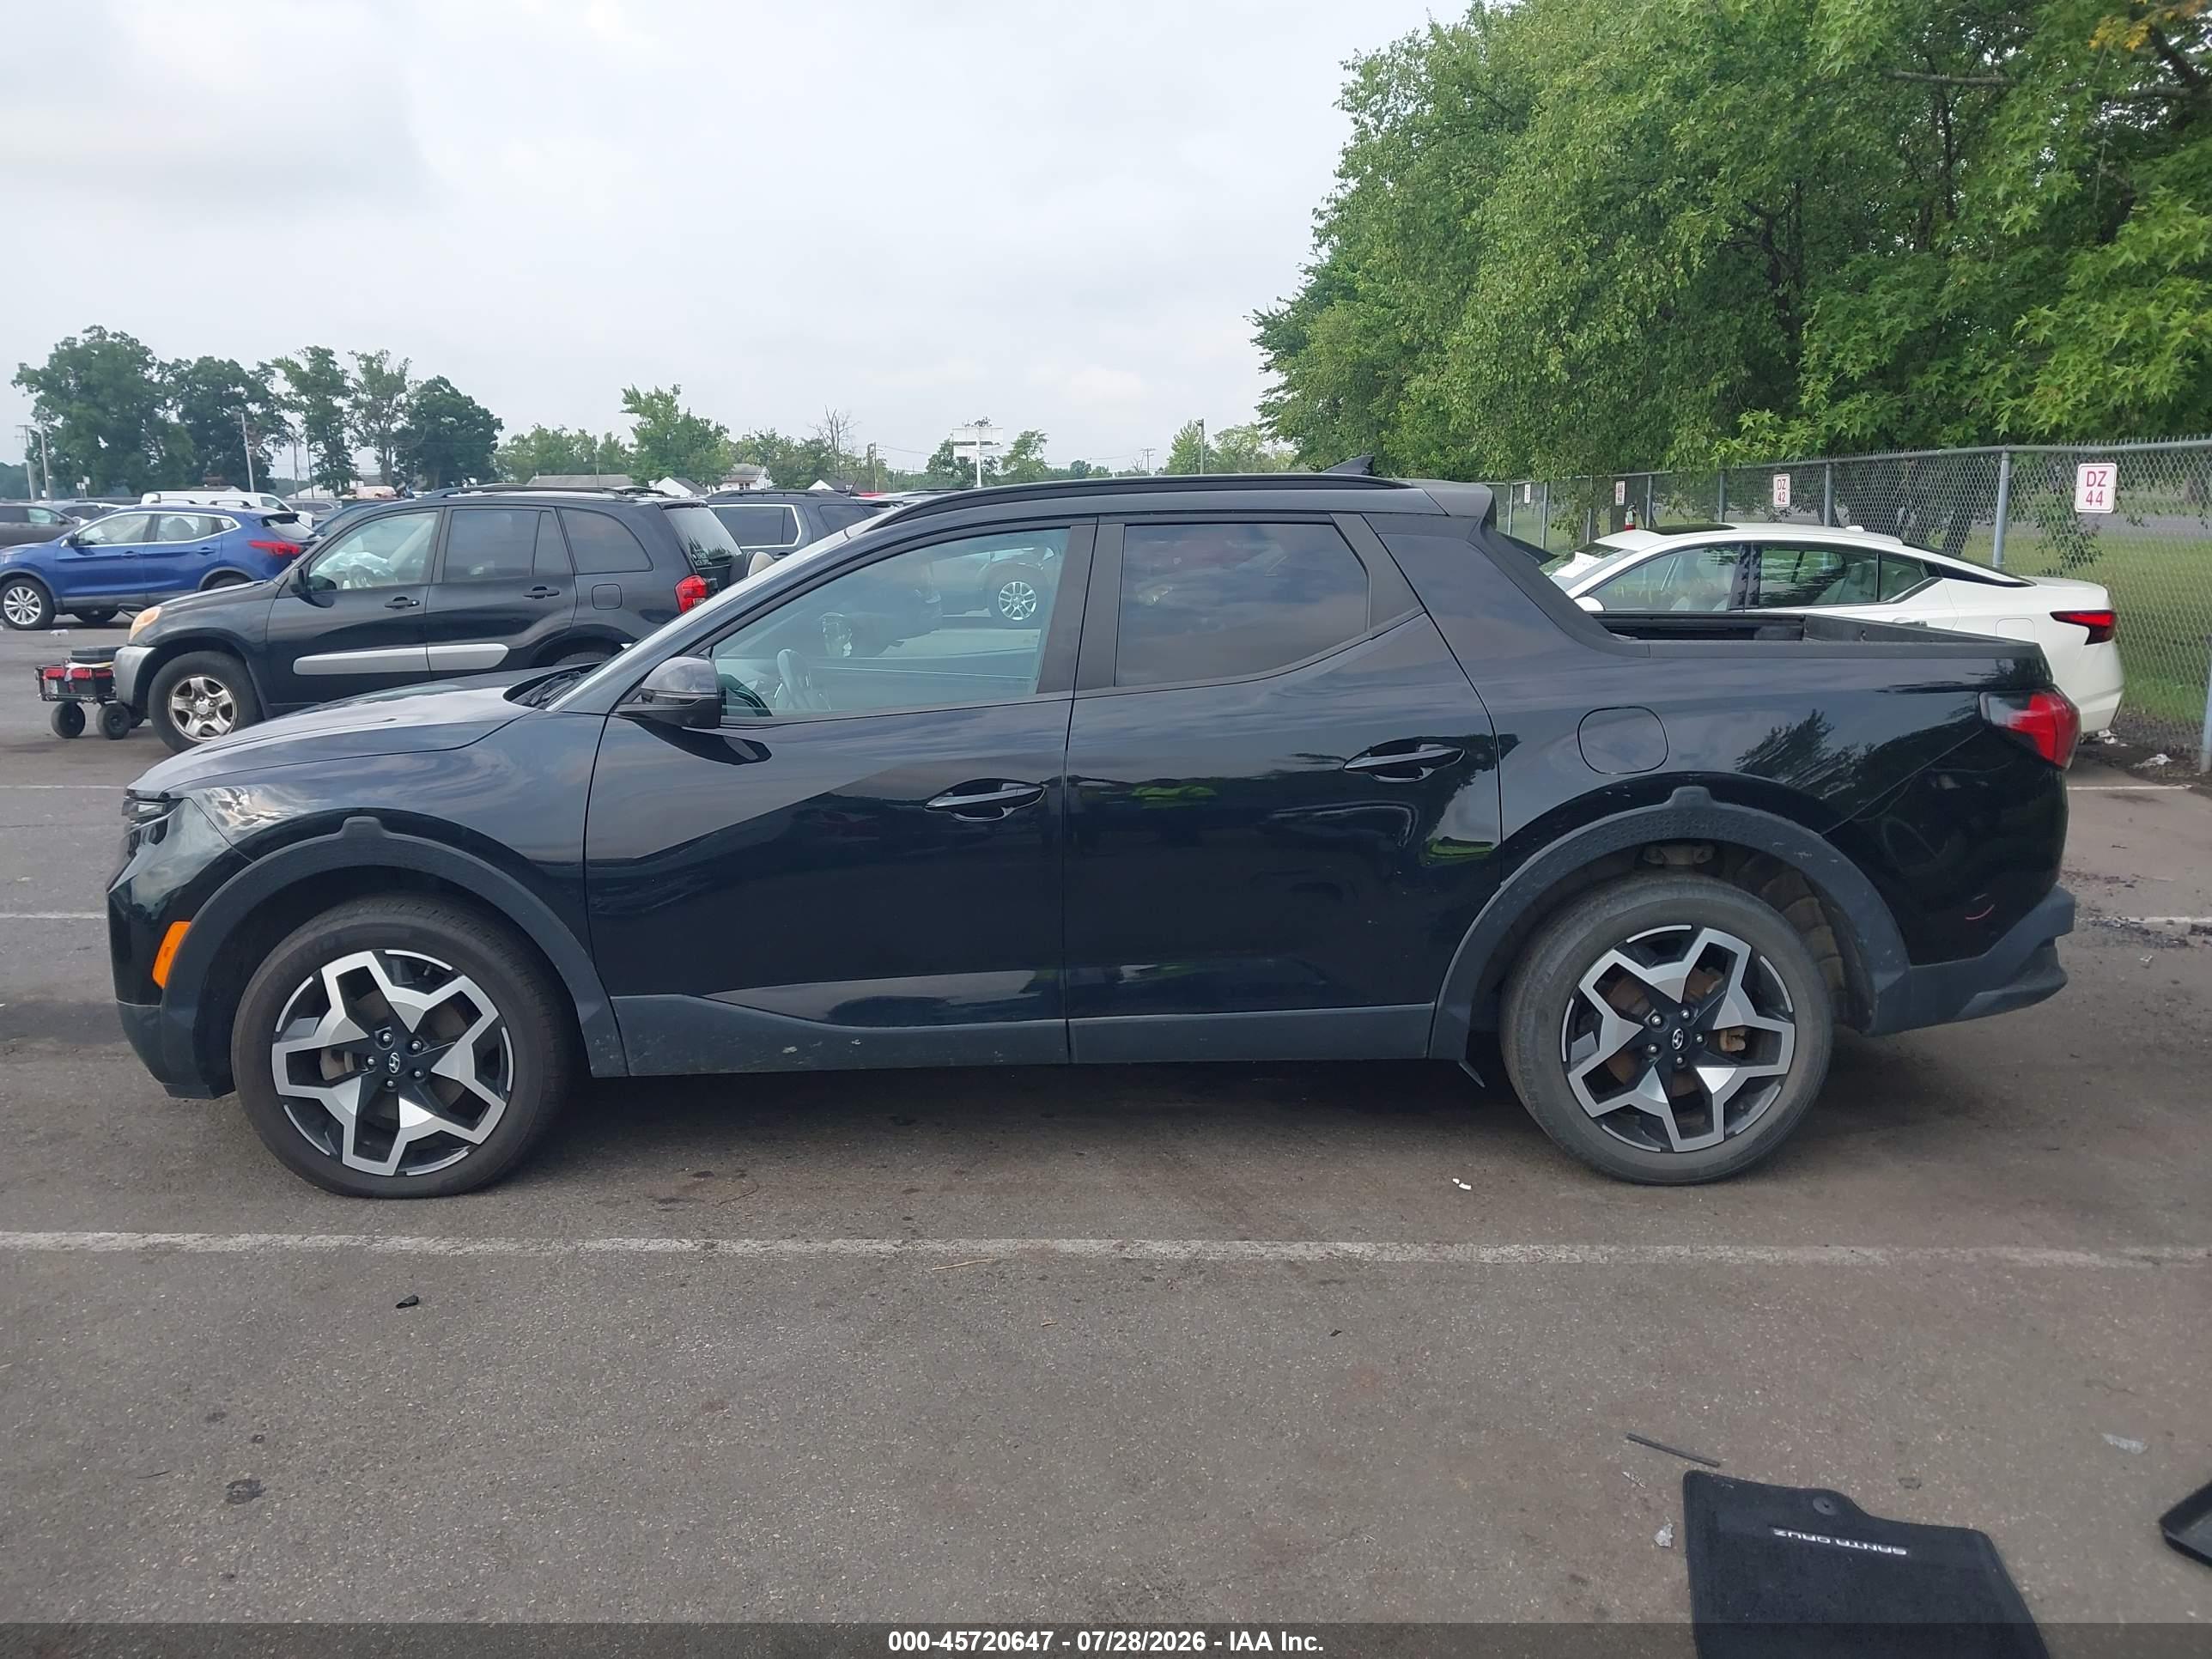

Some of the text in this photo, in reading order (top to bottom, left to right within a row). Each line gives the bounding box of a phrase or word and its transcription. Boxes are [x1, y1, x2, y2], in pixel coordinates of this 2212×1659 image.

[1777, 478, 1787, 490] DZ
[2086, 470, 2108, 487] DZ
[1778, 491, 1786, 502] 42
[2085, 489, 2104, 507] 44
[1835, 1537, 1908, 1555] SANTA
